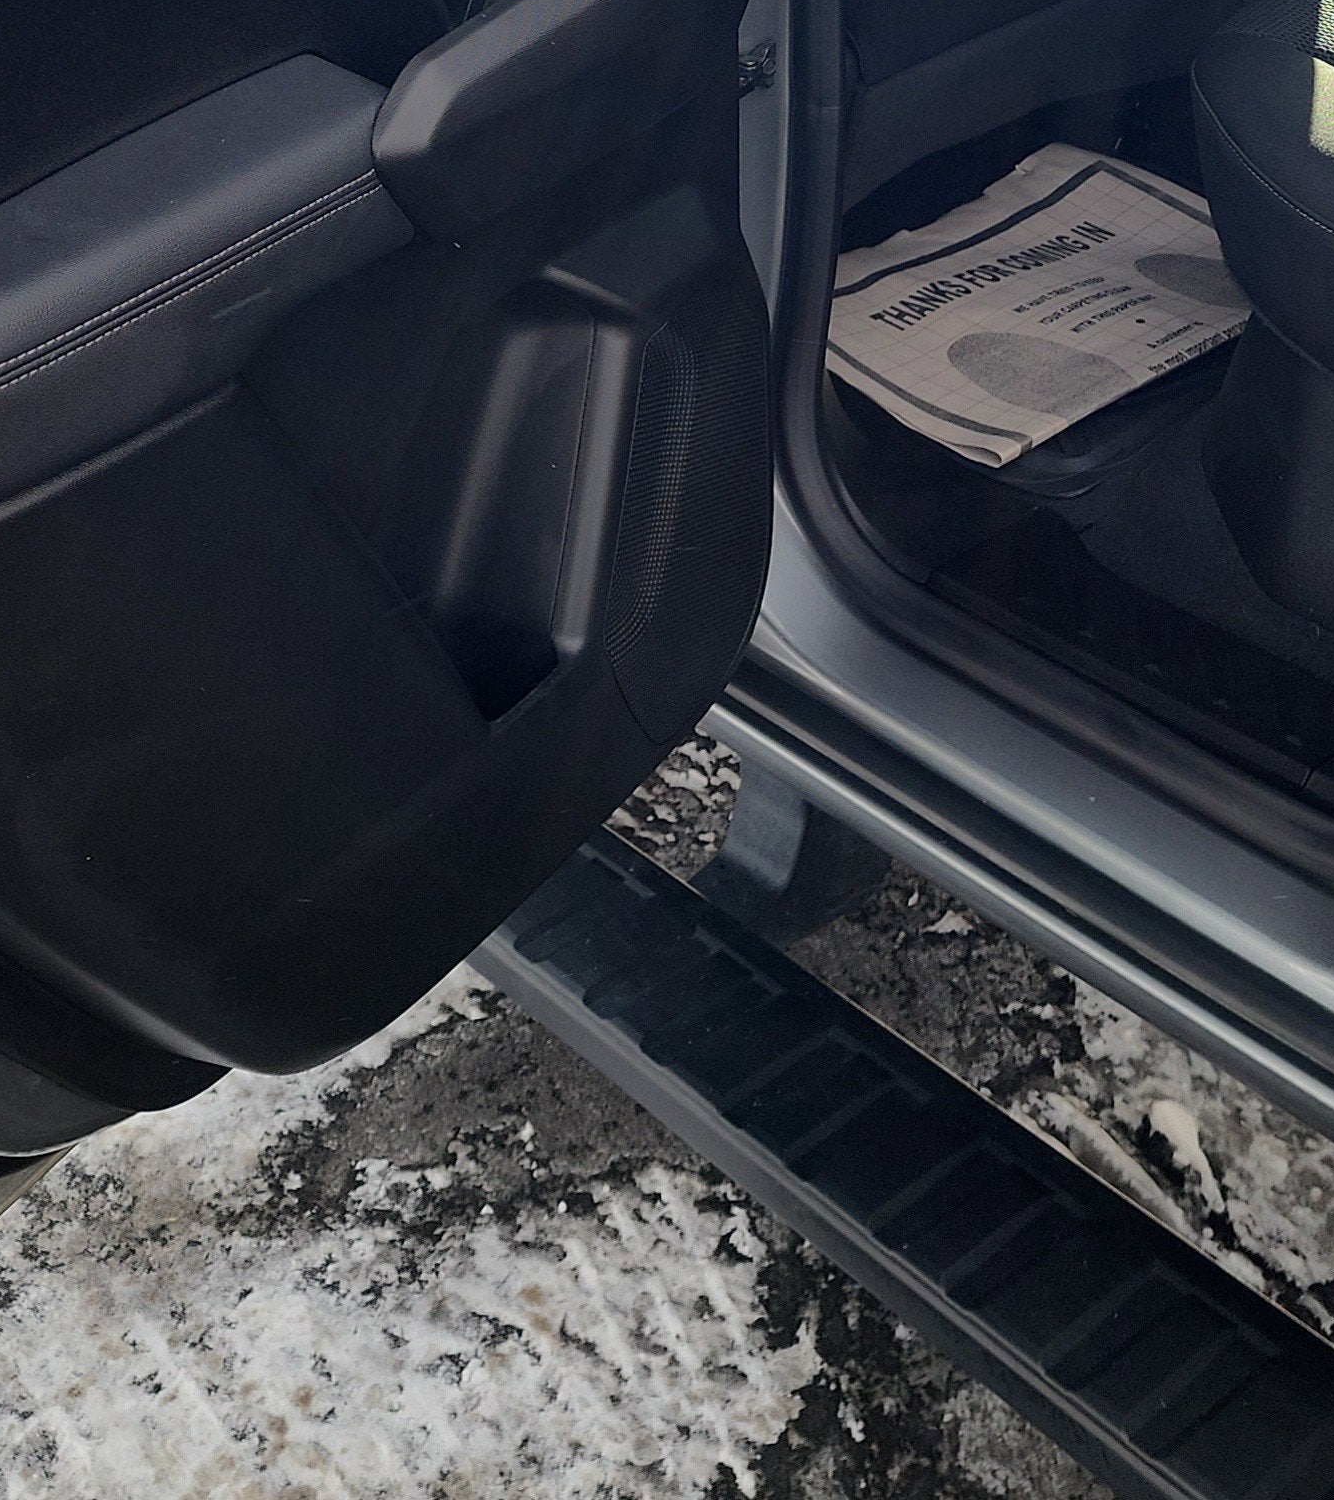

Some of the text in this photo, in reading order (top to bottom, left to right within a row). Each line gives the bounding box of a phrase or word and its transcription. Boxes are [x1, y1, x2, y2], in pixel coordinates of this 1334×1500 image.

[869, 220, 1116, 332] THANKS FOR COMING IN
